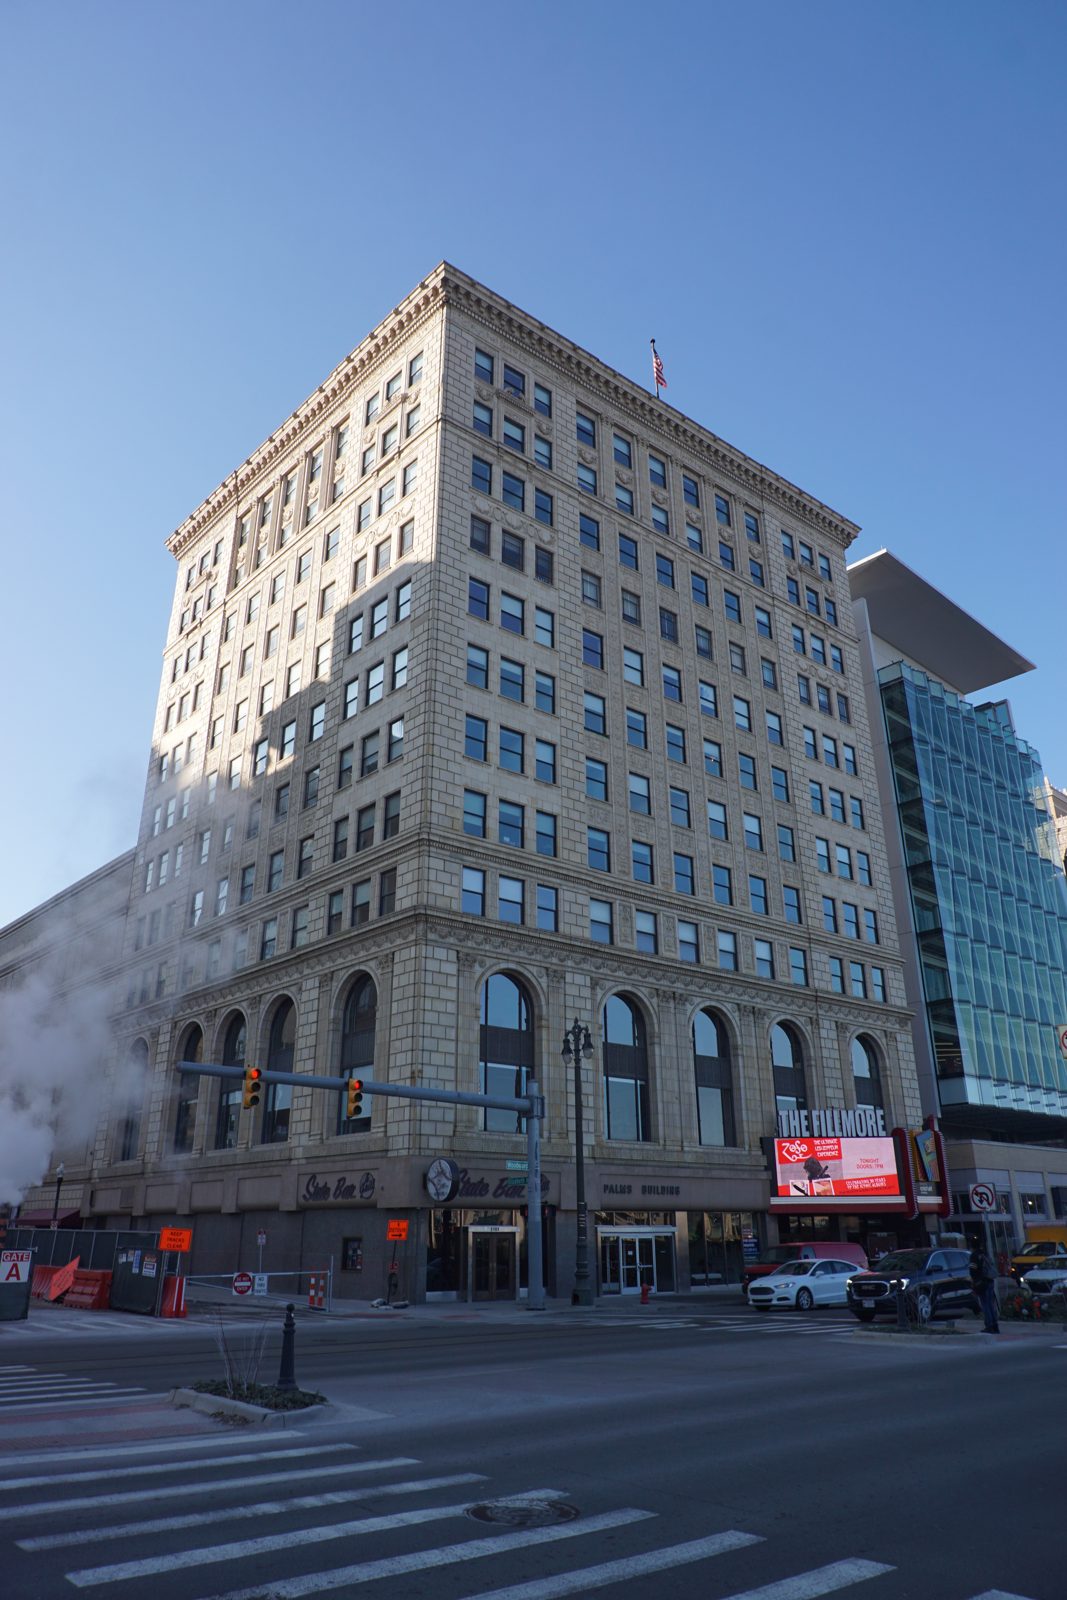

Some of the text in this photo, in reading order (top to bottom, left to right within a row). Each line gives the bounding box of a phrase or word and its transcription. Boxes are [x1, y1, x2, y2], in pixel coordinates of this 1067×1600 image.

[778, 1109, 887, 1137] THE FILLMORE
[302, 1174, 331, 1201] State
[333, 1176, 356, 1200] Bar
[458, 1168, 526, 1198] State Bar
[603, 1184, 680, 1195] PALMS BUILDING
[3, 1252, 30, 1262] GATE
[5, 1262, 21, 1281] A
